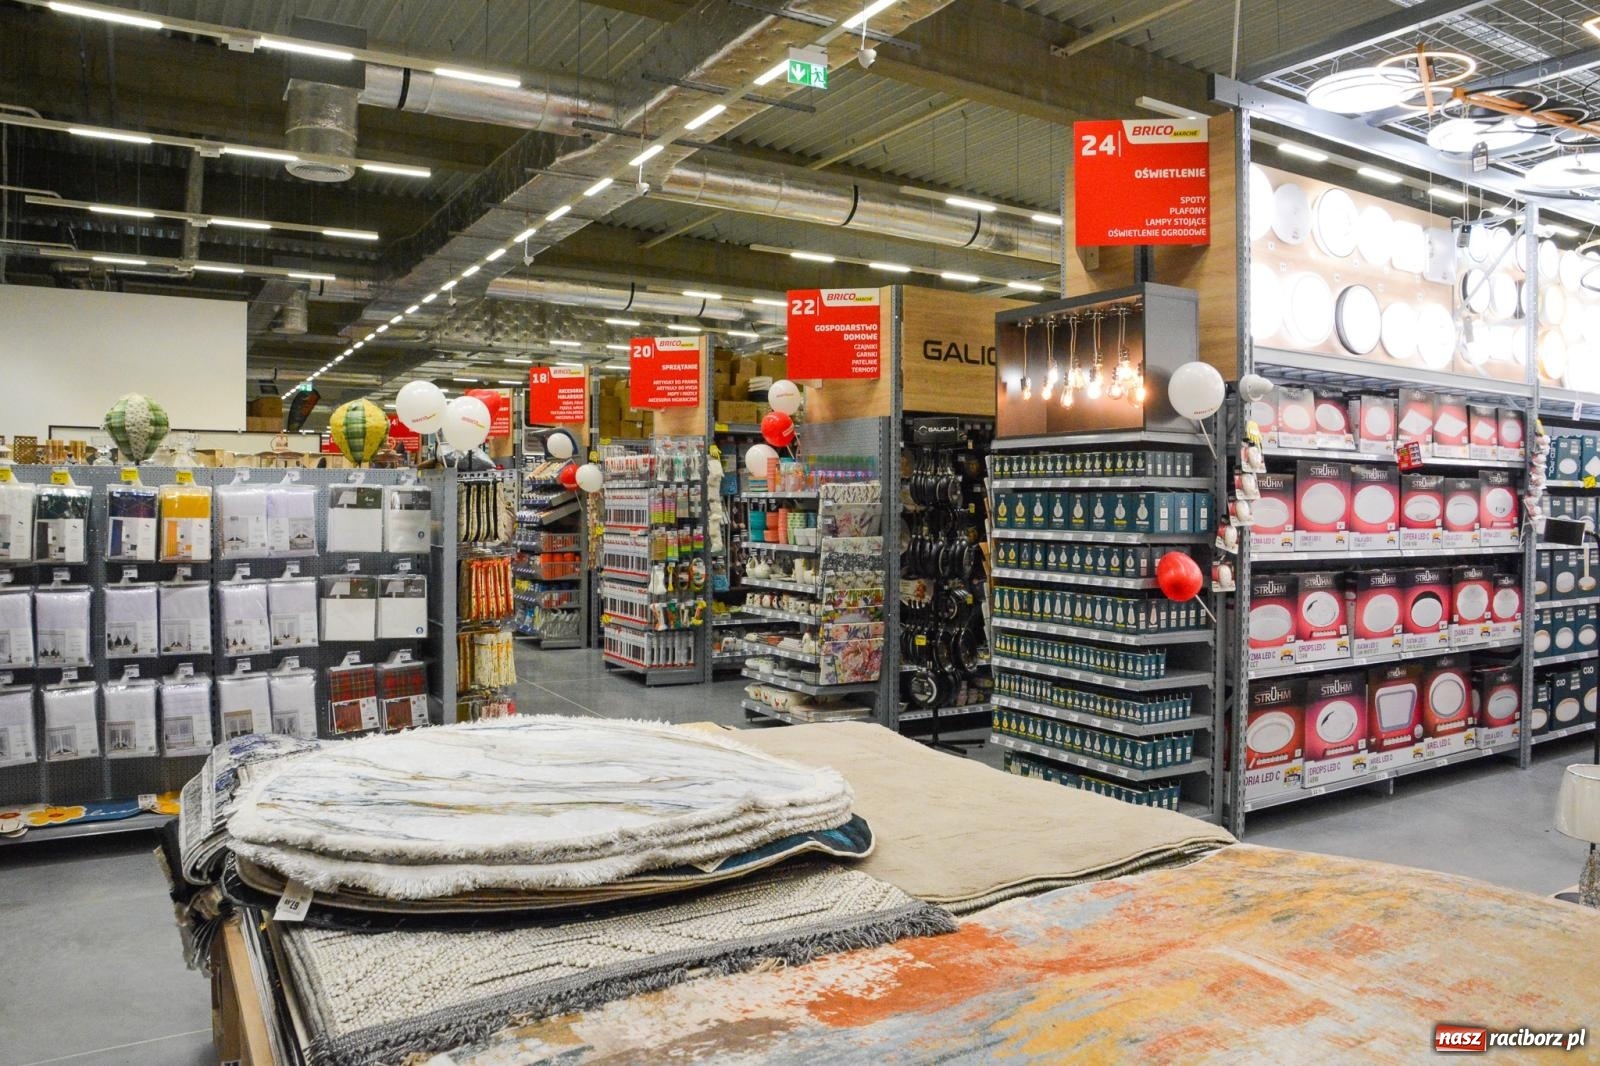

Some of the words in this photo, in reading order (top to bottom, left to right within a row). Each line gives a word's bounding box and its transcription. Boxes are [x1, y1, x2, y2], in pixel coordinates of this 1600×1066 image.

[1132, 125, 1174, 136] BRICO
[1081, 134, 1116, 156] 24
[1134, 168, 1206, 179] OŚWIETLENIE
[1180, 196, 1206, 204] SPOTY
[1169, 207, 1206, 215] PLAFONY
[1145, 218, 1171, 226] LAMPY
[1174, 218, 1206, 227] STOJĄCE
[1108, 228, 1159, 237] OŚWIETLENIE
[1161, 228, 1207, 236] OGRODOWE
[826, 293, 856, 301] BRICO
[791, 299, 815, 315] 22
[814, 324, 878, 332] GOSPODARSTWO
[843, 333, 878, 341] DOMOWE
[633, 345, 651, 358] 20
[532, 373, 547, 384] 18
[1320, 680, 1352, 695] STRÜHM
[1254, 686, 1291, 704] STRÜHM
[1309, 765, 1327, 776] DROPS
[1327, 763, 1337, 772] LED
[1261, 772, 1274, 783] LED
[1275, 771, 1281, 781] C
